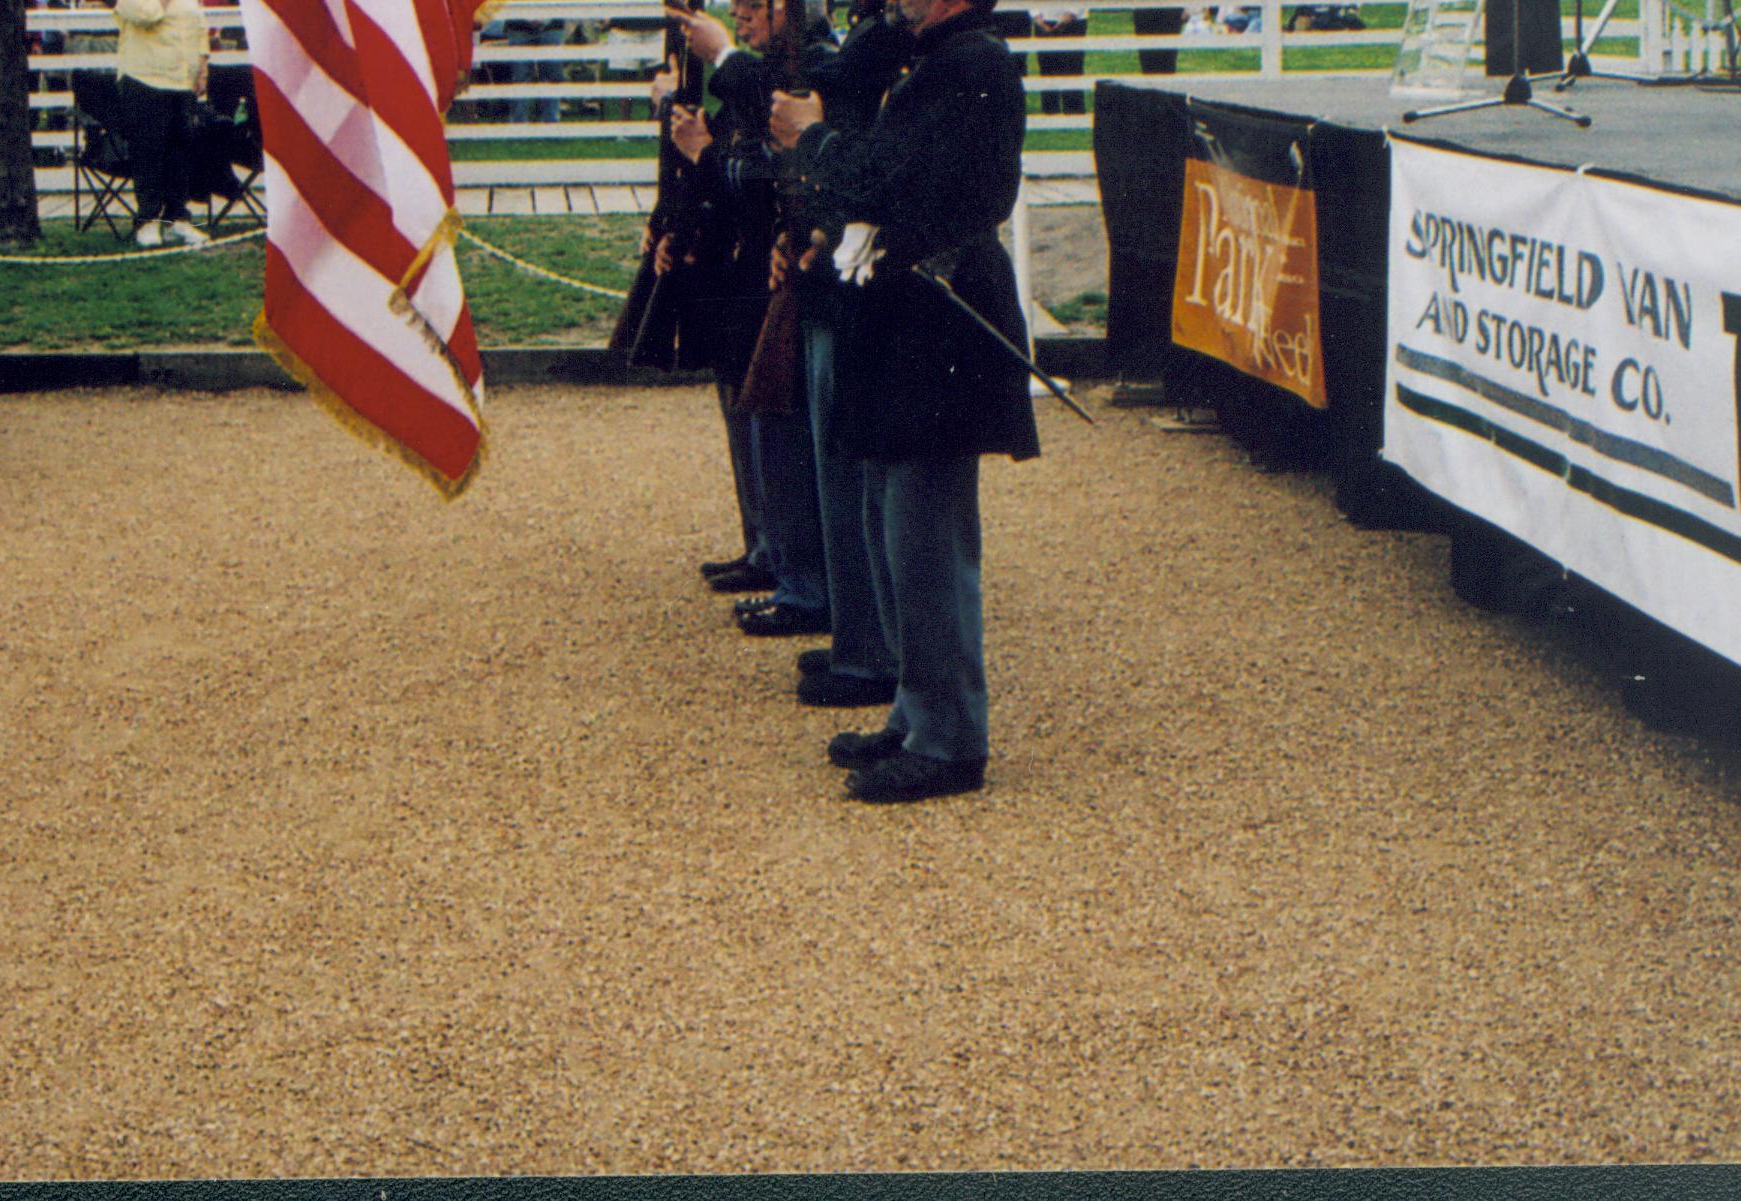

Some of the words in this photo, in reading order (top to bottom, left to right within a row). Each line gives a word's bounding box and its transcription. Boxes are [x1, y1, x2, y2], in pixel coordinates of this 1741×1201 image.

[1405, 209, 1605, 310] SPRINGFIELD
[1616, 260, 1693, 351] VAN
[1415, 290, 1469, 344] AND
[1476, 308, 1597, 398] STORAGE
[1610, 356, 1671, 426] CO.
